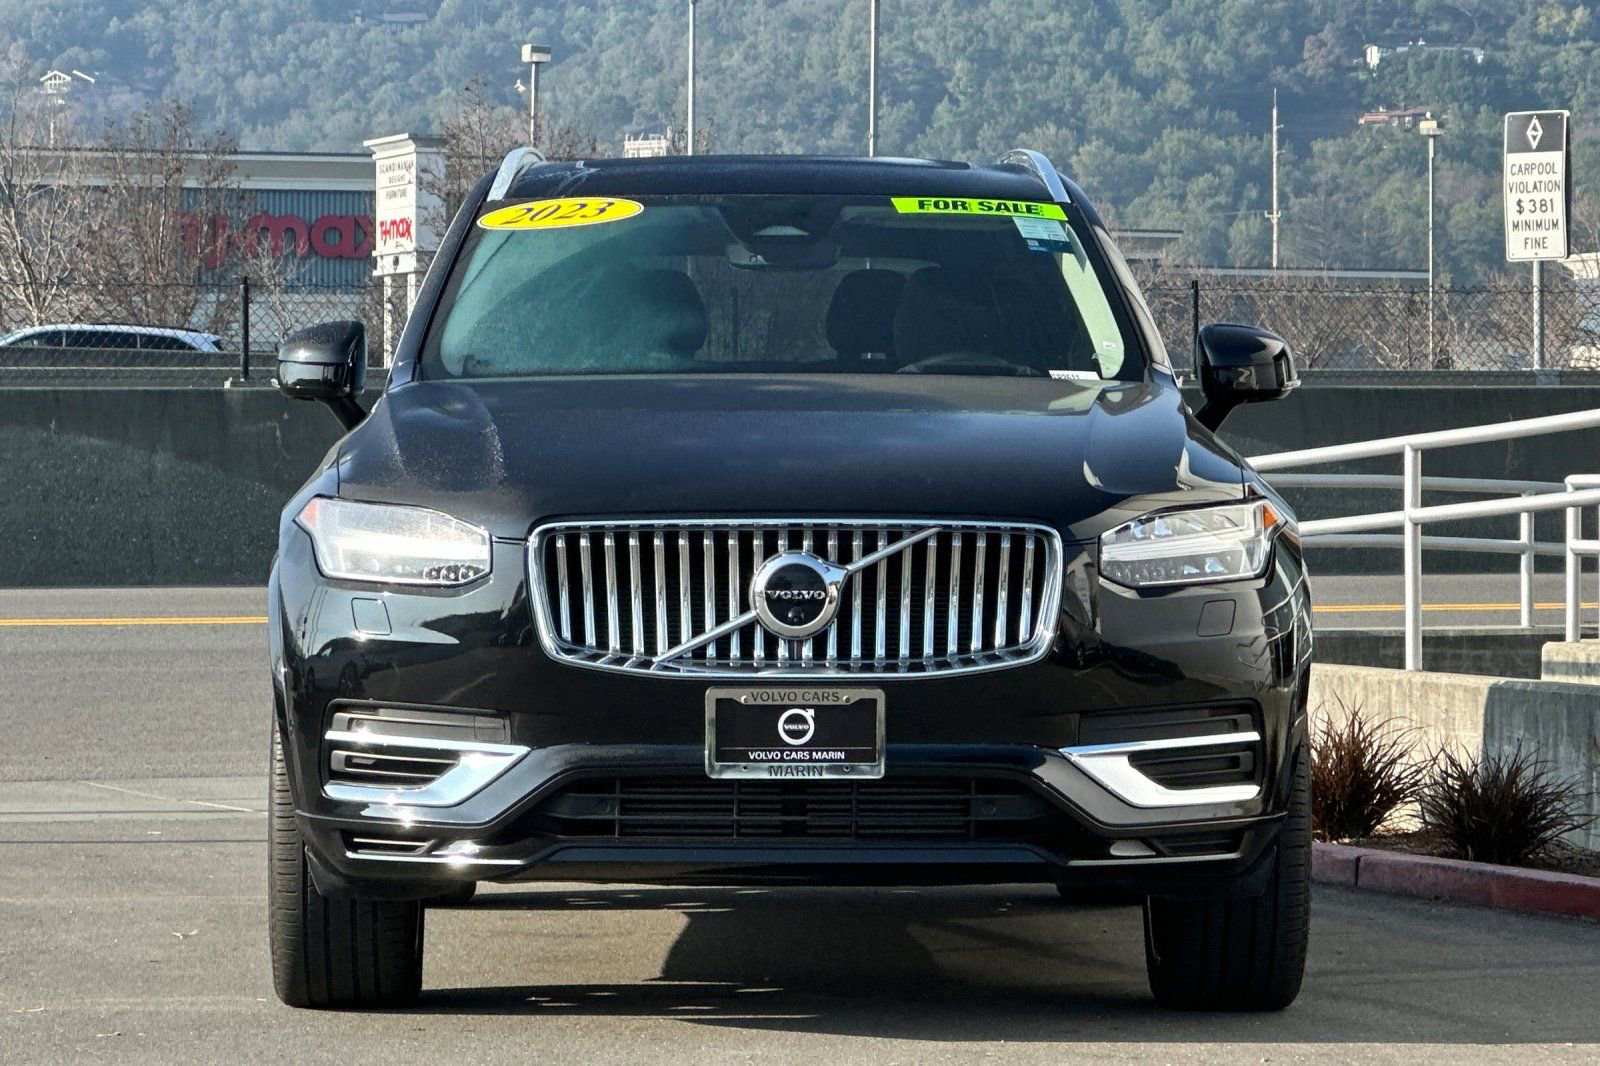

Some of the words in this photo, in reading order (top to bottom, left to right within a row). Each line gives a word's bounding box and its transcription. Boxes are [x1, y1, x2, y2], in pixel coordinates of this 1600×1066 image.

[1510, 162, 1558, 176] CARPOOL
[1508, 180, 1561, 194] VIOLATION
[500, 202, 615, 225] 2023
[918, 200, 968, 211] FOR
[978, 201, 1040, 215] SALE
[1516, 198, 1555, 215] $381
[1512, 218, 1560, 232] MINIMUM
[1524, 237, 1549, 250] FINE
[766, 590, 826, 600] VOLVO
[751, 691, 798, 702] VOLVO
[801, 691, 840, 702] CARS
[748, 751, 781, 760] VOLVO
[783, 751, 810, 760] CARS
[812, 751, 845, 760] MARIN
[769, 765, 824, 777] MARIN
